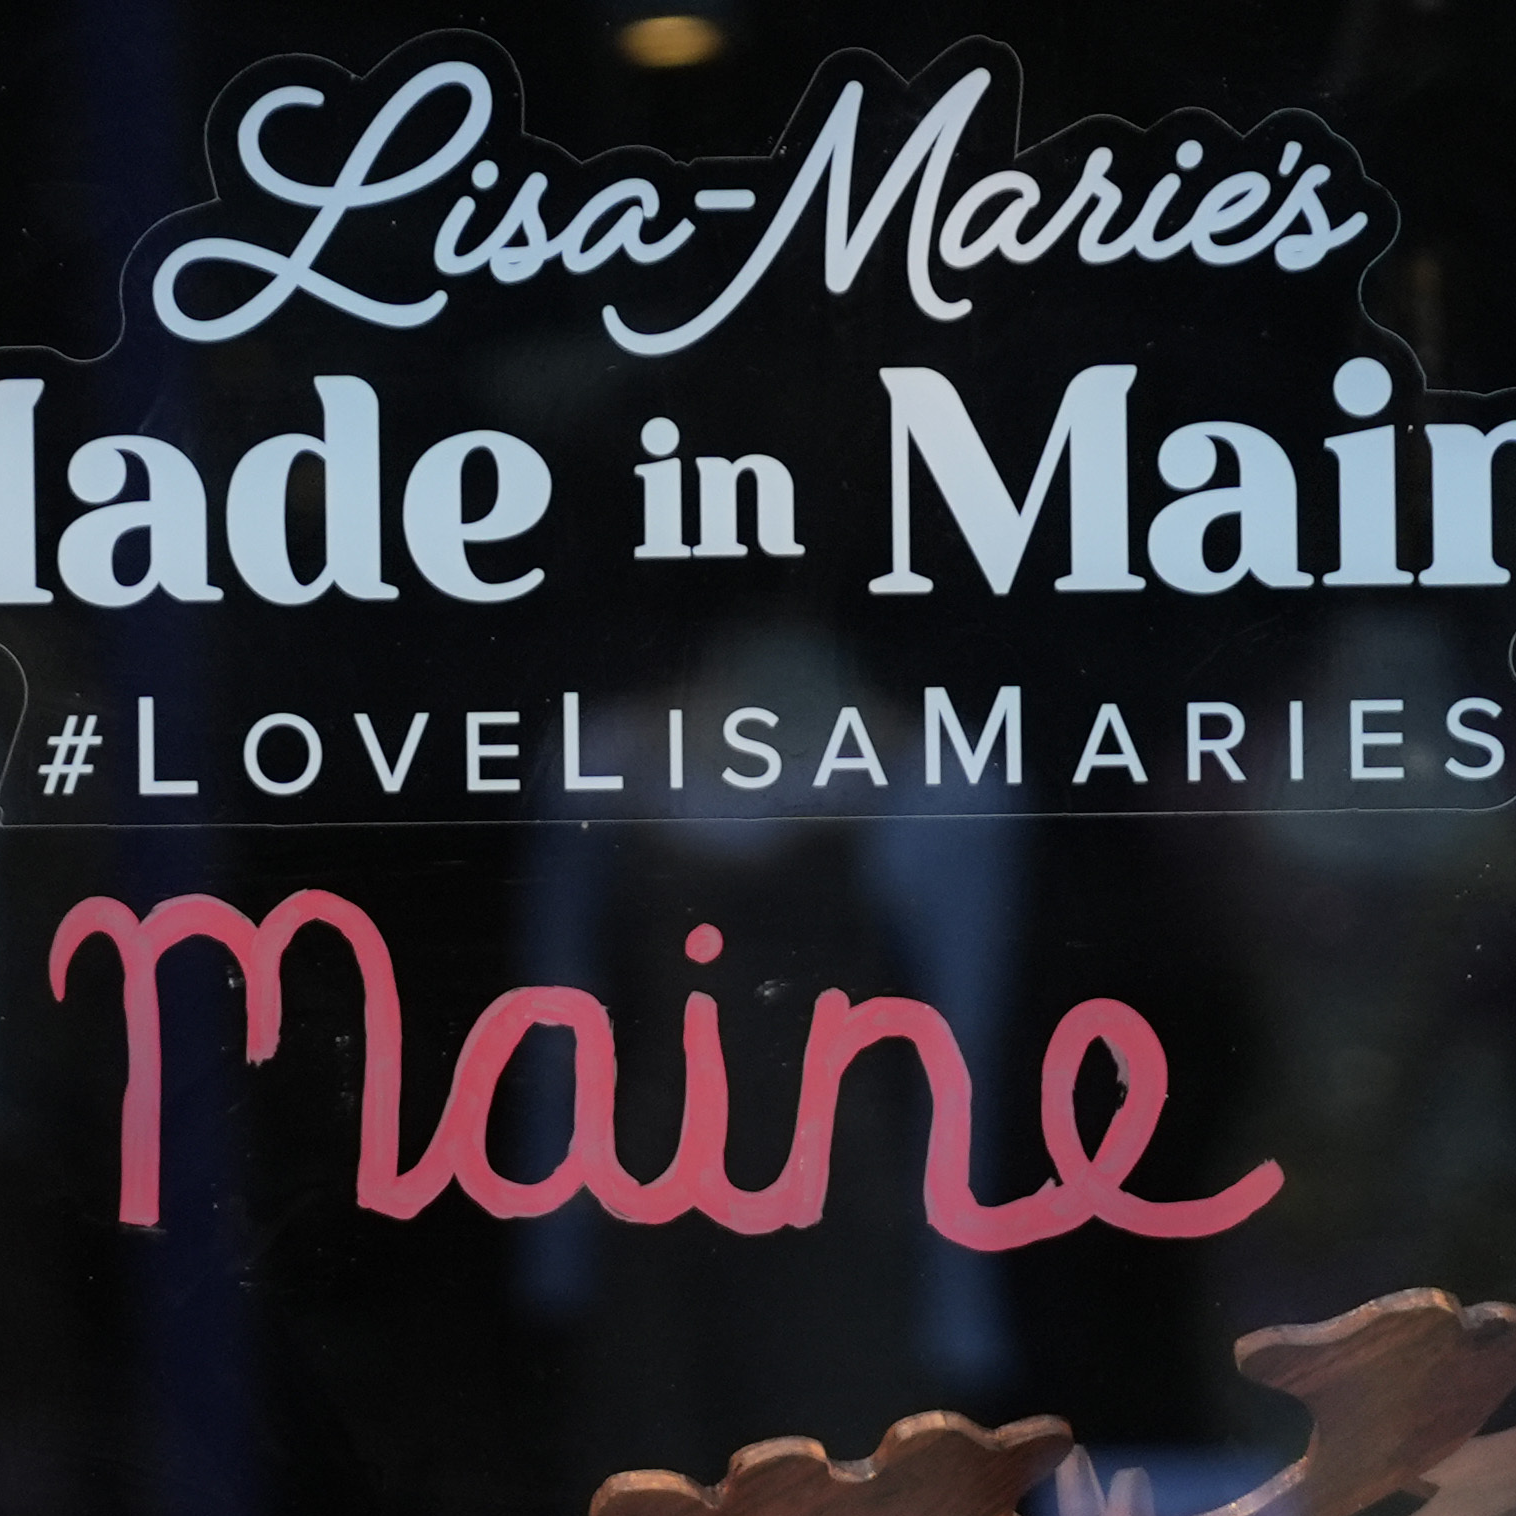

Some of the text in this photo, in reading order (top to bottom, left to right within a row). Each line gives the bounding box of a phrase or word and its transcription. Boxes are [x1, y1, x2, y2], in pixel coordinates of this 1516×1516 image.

[153, 62, 1367, 355] Lisa-Marie's
[634, 418, 806, 558] in
[49, 889, 1286, 1252] Maine
